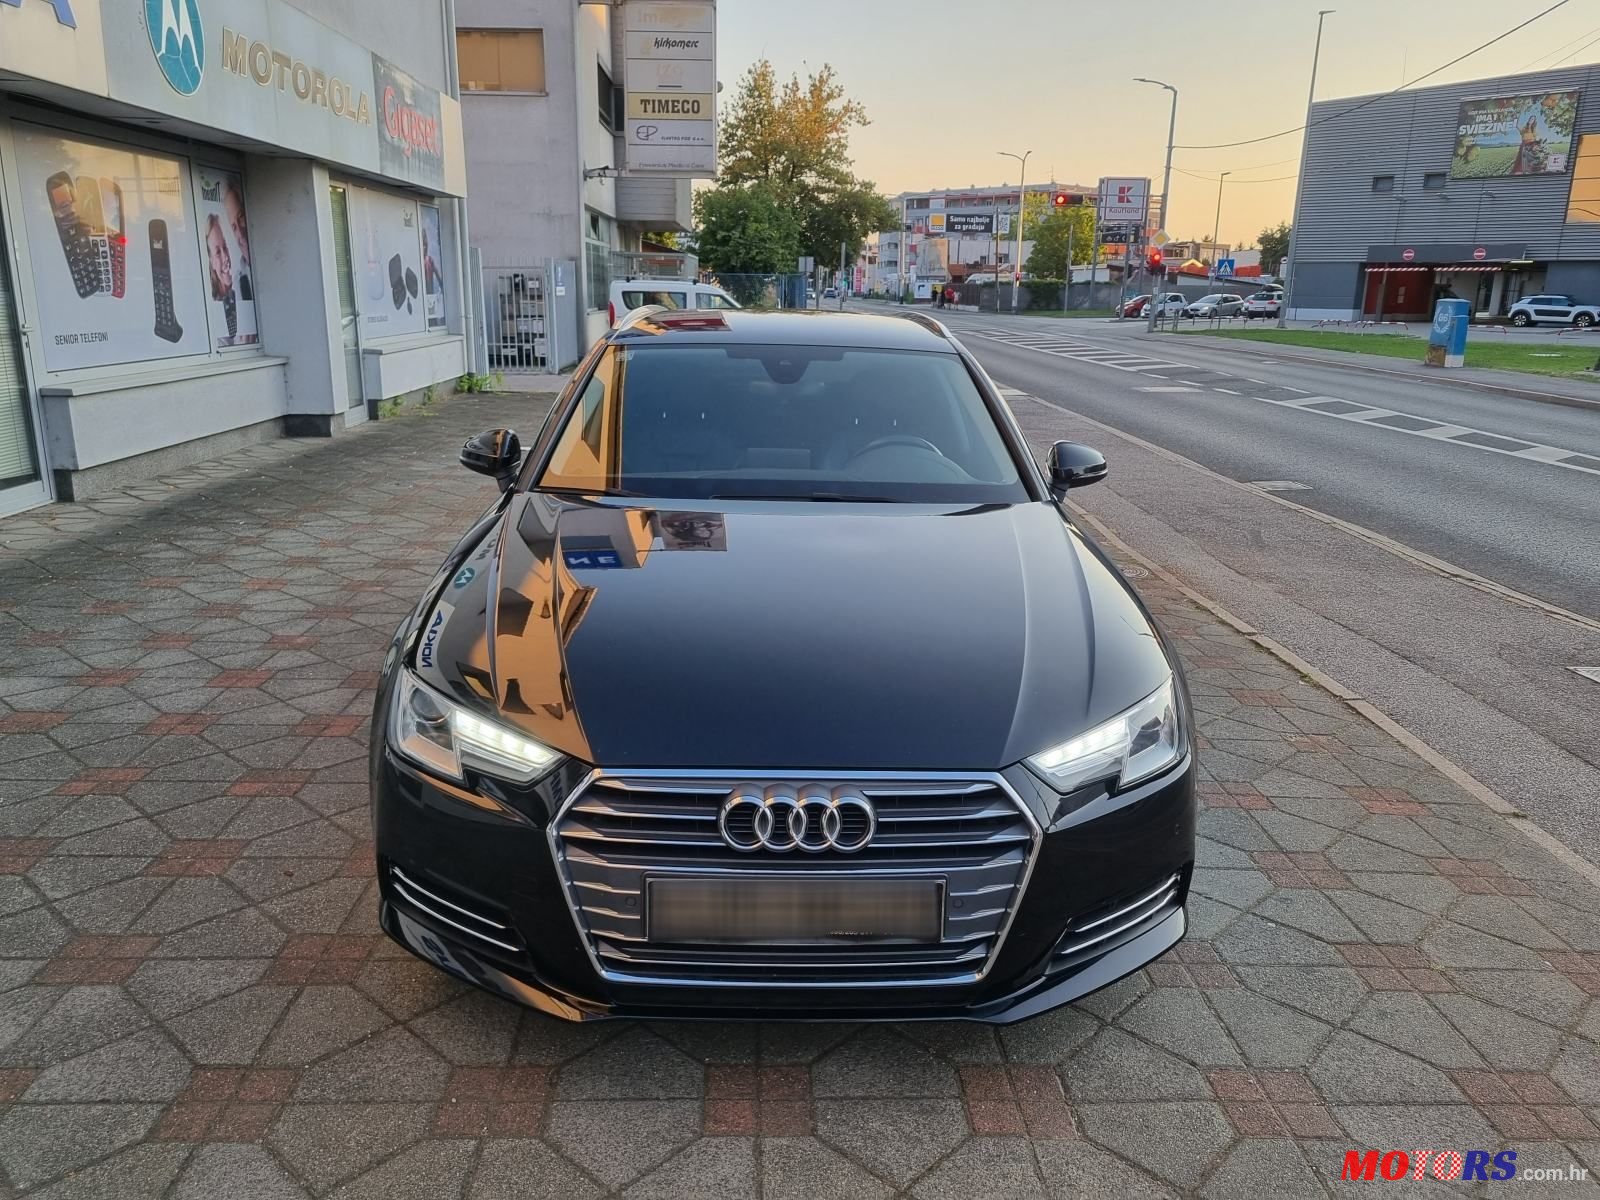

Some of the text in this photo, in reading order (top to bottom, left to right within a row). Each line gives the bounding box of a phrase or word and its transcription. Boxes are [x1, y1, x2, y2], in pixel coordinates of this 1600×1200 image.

[653, 37, 699, 49] kirkomerc
[222, 25, 371, 126] MOTOROLA
[640, 99, 700, 114] TIMECO
[967, 215, 990, 224] najbolje
[54, 332, 109, 346] SENIOR TELEFONI
